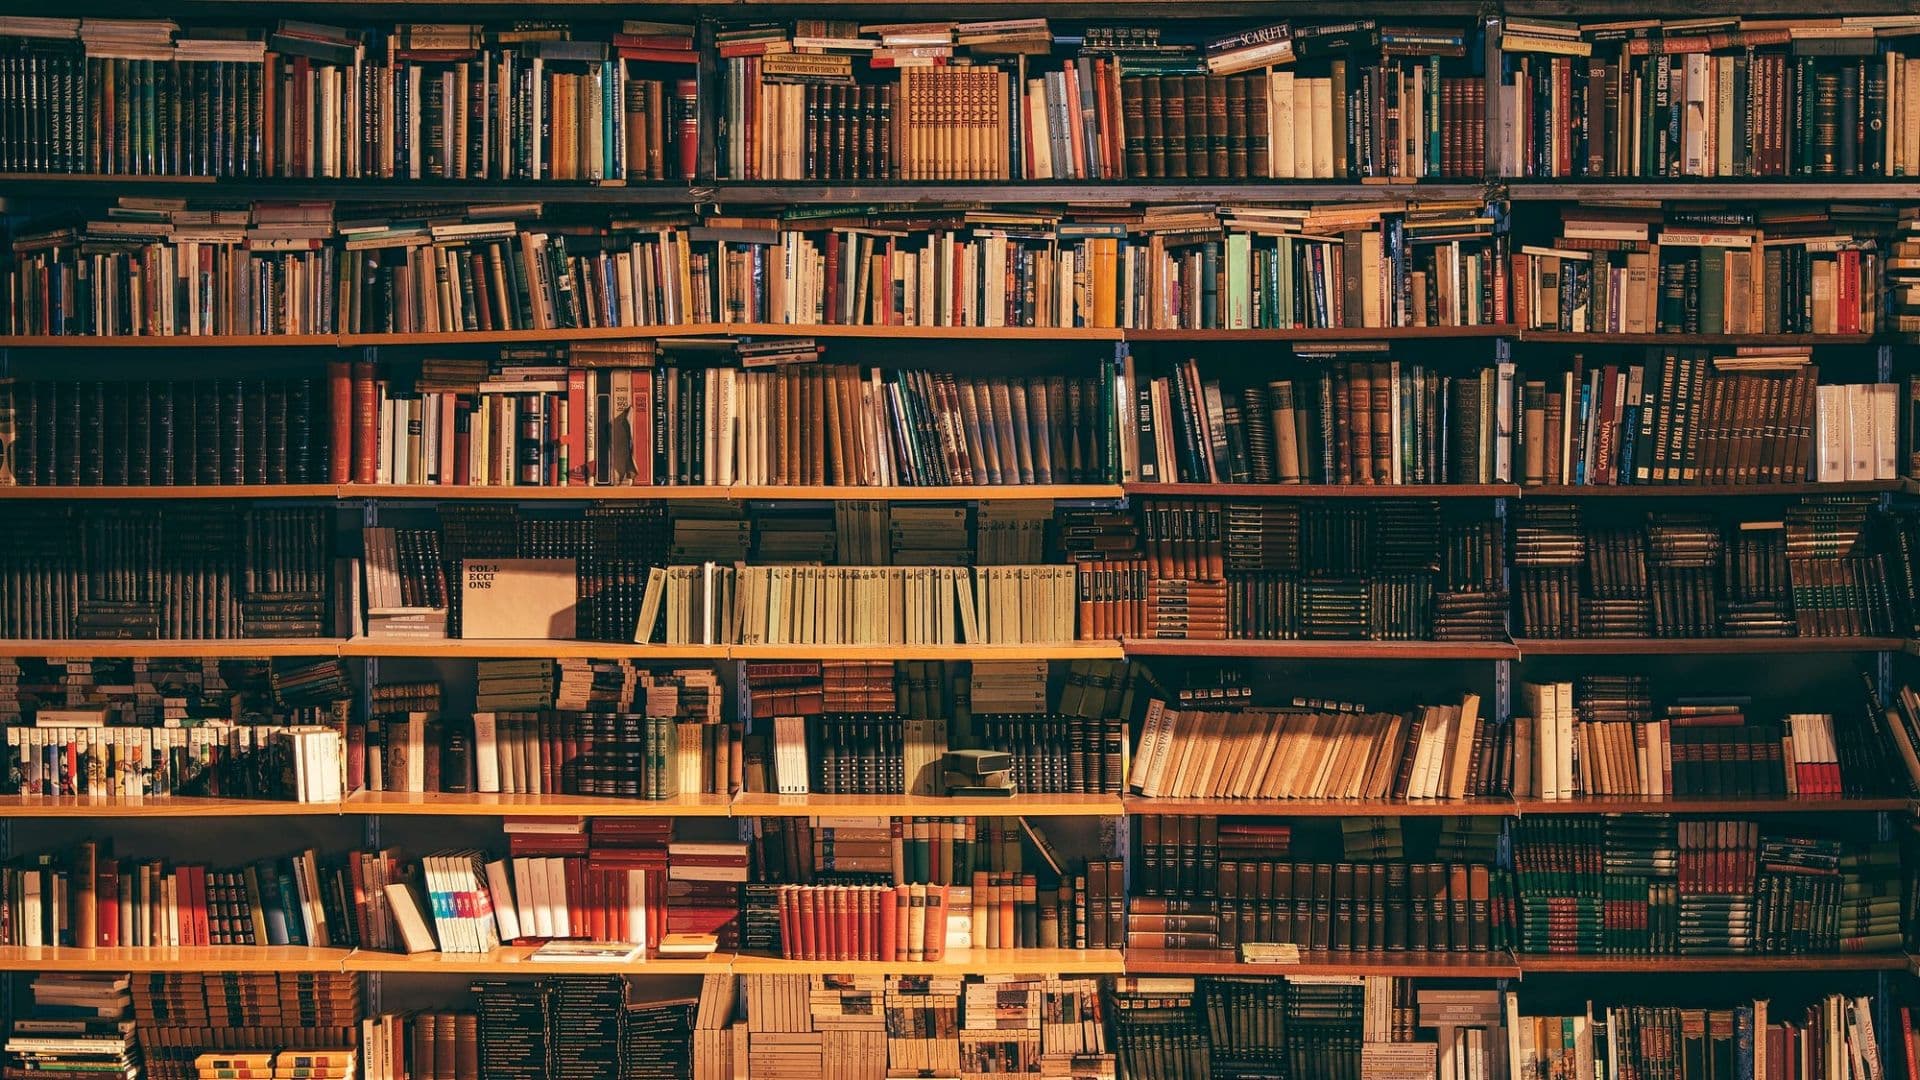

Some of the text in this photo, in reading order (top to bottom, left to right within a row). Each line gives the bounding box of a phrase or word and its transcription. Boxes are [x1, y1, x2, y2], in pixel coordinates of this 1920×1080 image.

[1240, 23, 1289, 46] SCARLETT
[910, 72, 918, 128] BRICOLAJE
[918, 72, 926, 128] BRICOLAJE
[926, 72, 934, 128] BRICOLAJE
[935, 72, 944, 128] BRICOLAJE
[944, 72, 952, 128] BRICOLAJE
[952, 72, 960, 128] BRICOLAJE
[962, 72, 970, 128] BRICOLAJE
[971, 72, 980, 128] BRICOLAJE
[980, 72, 989, 128] BRICOLAJE
[990, 72, 998, 128] BRICOLAJE
[1657, 56, 1668, 106] LAS CIENCIAS
[52, 74, 60, 155] LAS RAZAS HUMANAS
[64, 75, 72, 156] LAS RAZAS HUMANAS
[76, 76, 84, 156] LAS RAZAS HUMANAS
[1362, 75, 1370, 158] GRANDES EXPLORACIONES
[1140, 404, 1150, 422] SIGLO
[1642, 408, 1653, 425] SIGLO
[1644, 394, 1654, 404] XX
[1656, 356, 1675, 460] CIVILIZACIONES EXTINGUIDAS
[1674, 414, 1684, 423] DE
[1676, 402, 1685, 410] LA
[1687, 452, 1694, 460] LA
[1692, 358, 1705, 401] OCCIDENTAL
[1141, 424, 1150, 432] EL
[1598, 420, 1610, 470] CATALONIA
[1672, 452, 1680, 460] LA
[1156, 716, 1172, 757] PARNASO
